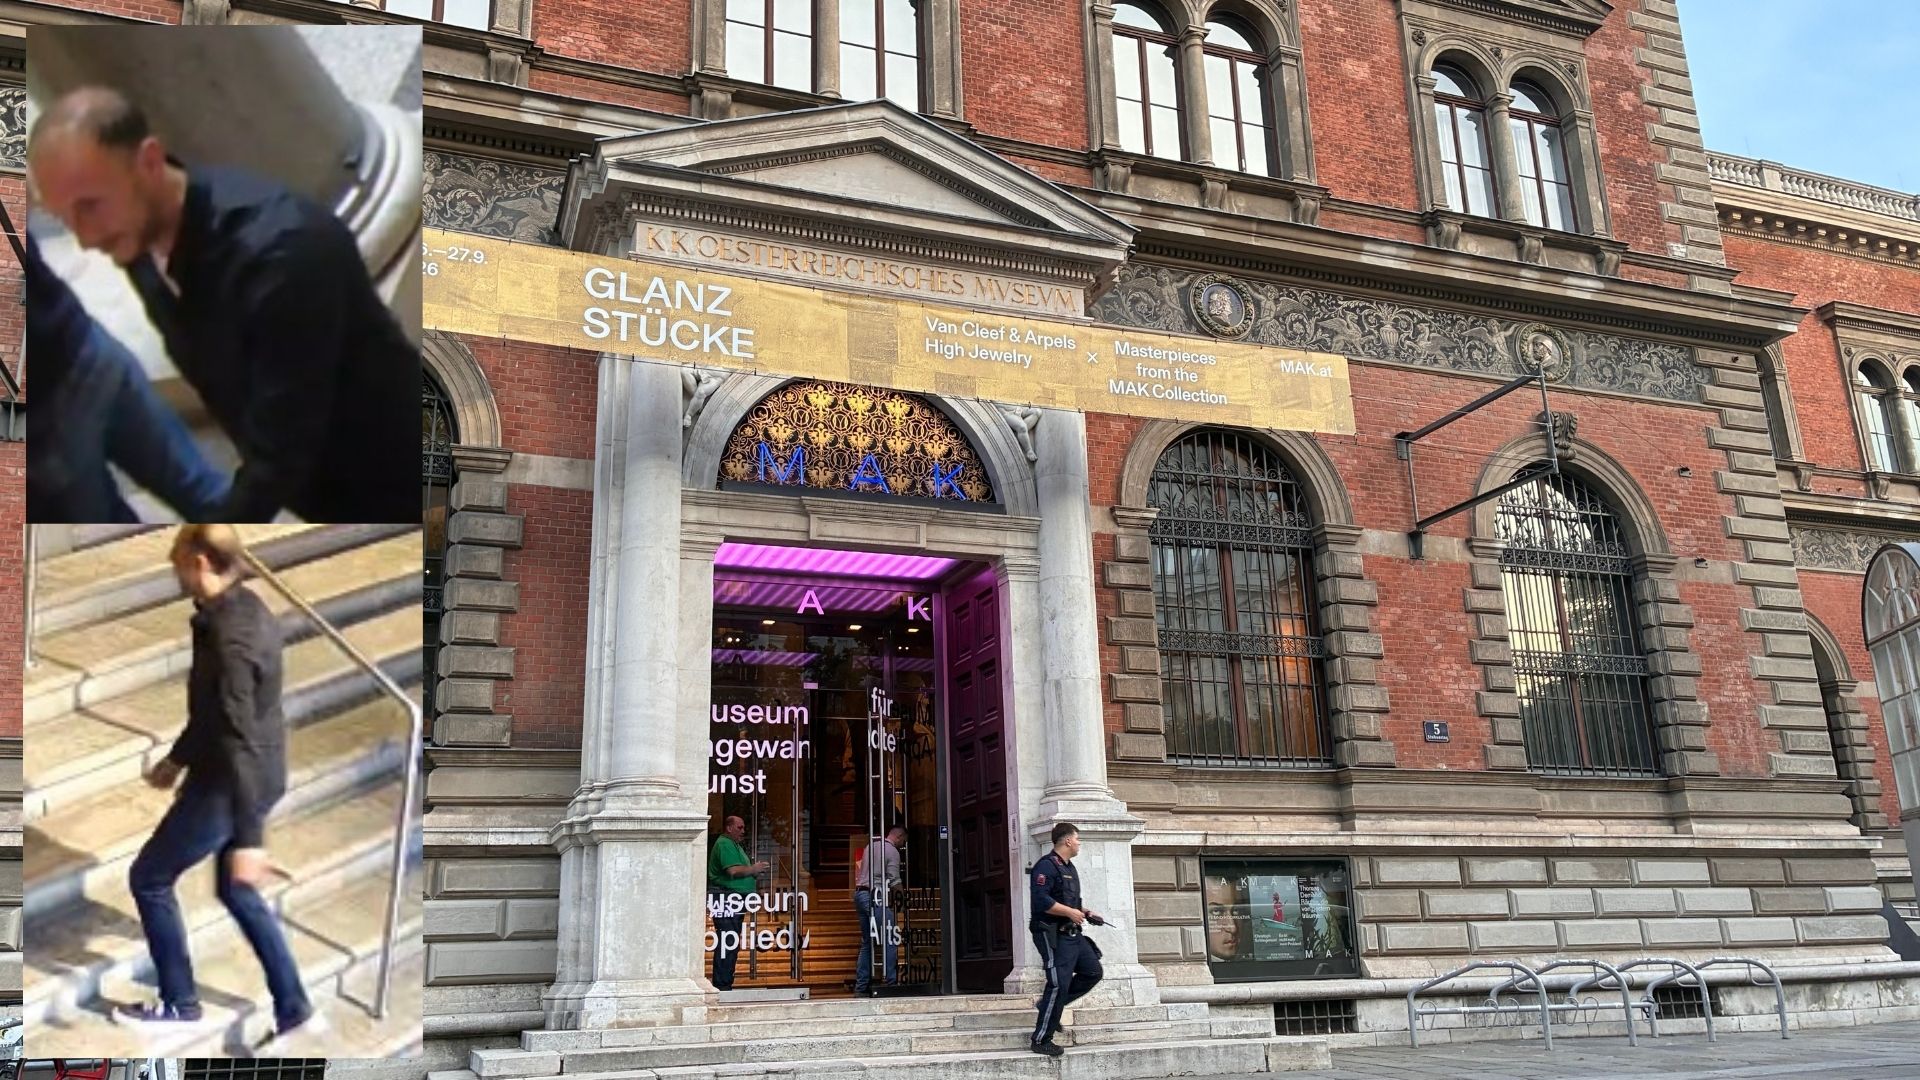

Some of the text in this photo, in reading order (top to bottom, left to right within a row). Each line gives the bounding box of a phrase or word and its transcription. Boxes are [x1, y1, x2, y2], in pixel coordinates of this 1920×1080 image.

[696, 234, 965, 296] OESTERREICHISCHES
[584, 267, 732, 317] GLANZ
[582, 307, 755, 359] STÜCKE
[925, 316, 1077, 350] Van Cleef & Arpels
[925, 338, 1033, 368] High Jewelry
[1114, 340, 1217, 365] Masterpieces
[1136, 363, 1199, 383] from the
[1280, 359, 1334, 378] MAK.at
[1109, 378, 1229, 405] MAK Collection
[871, 686, 894, 717] für
[1433, 724, 1440, 735] 5
